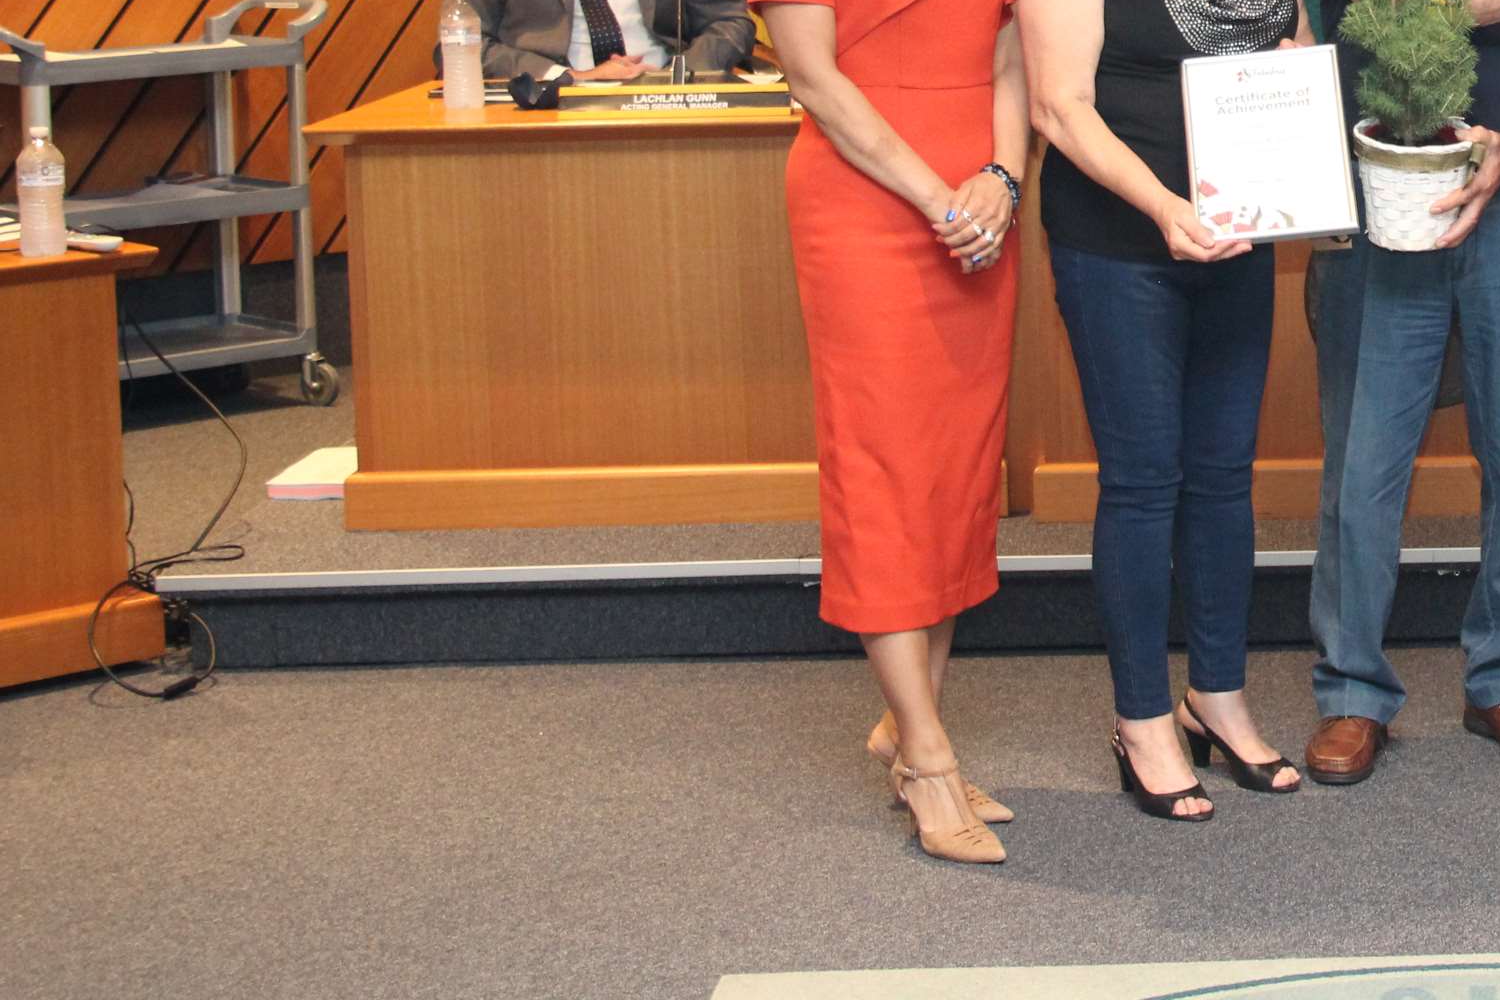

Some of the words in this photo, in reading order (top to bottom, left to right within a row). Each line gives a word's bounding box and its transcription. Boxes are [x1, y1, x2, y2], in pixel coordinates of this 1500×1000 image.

[633, 93, 684, 104] LACHLAN
[686, 92, 717, 103] GUNN
[1214, 90, 1291, 106] Certificate
[1296, 86, 1310, 97] of
[651, 103, 687, 111] GENERAL
[689, 102, 729, 110] MANAGER
[1217, 97, 1311, 116] Achievement
